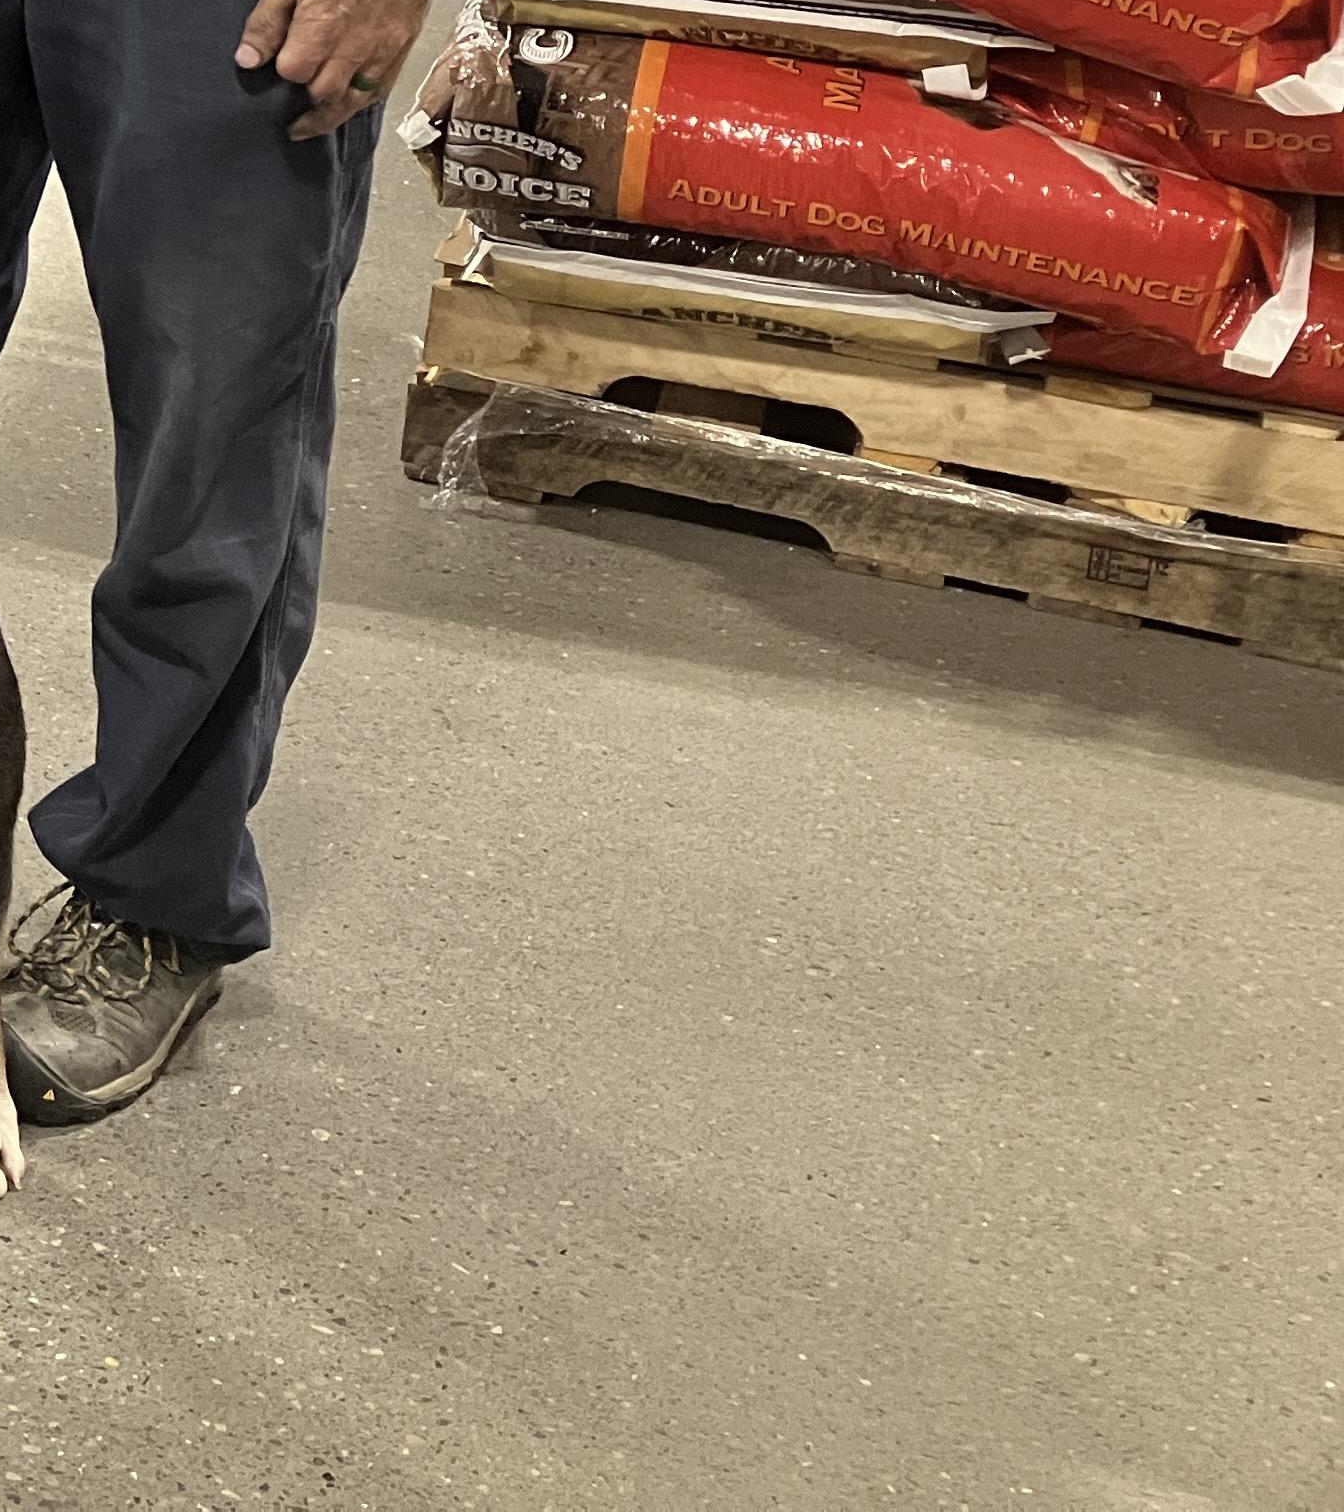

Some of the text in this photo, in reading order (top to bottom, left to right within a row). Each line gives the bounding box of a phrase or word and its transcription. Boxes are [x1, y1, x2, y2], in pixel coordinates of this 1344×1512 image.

[1243, 128, 1333, 154] DOG
[443, 155, 592, 209] HOICE
[667, 178, 1204, 308] ADULT DOG MAINTENANCE
